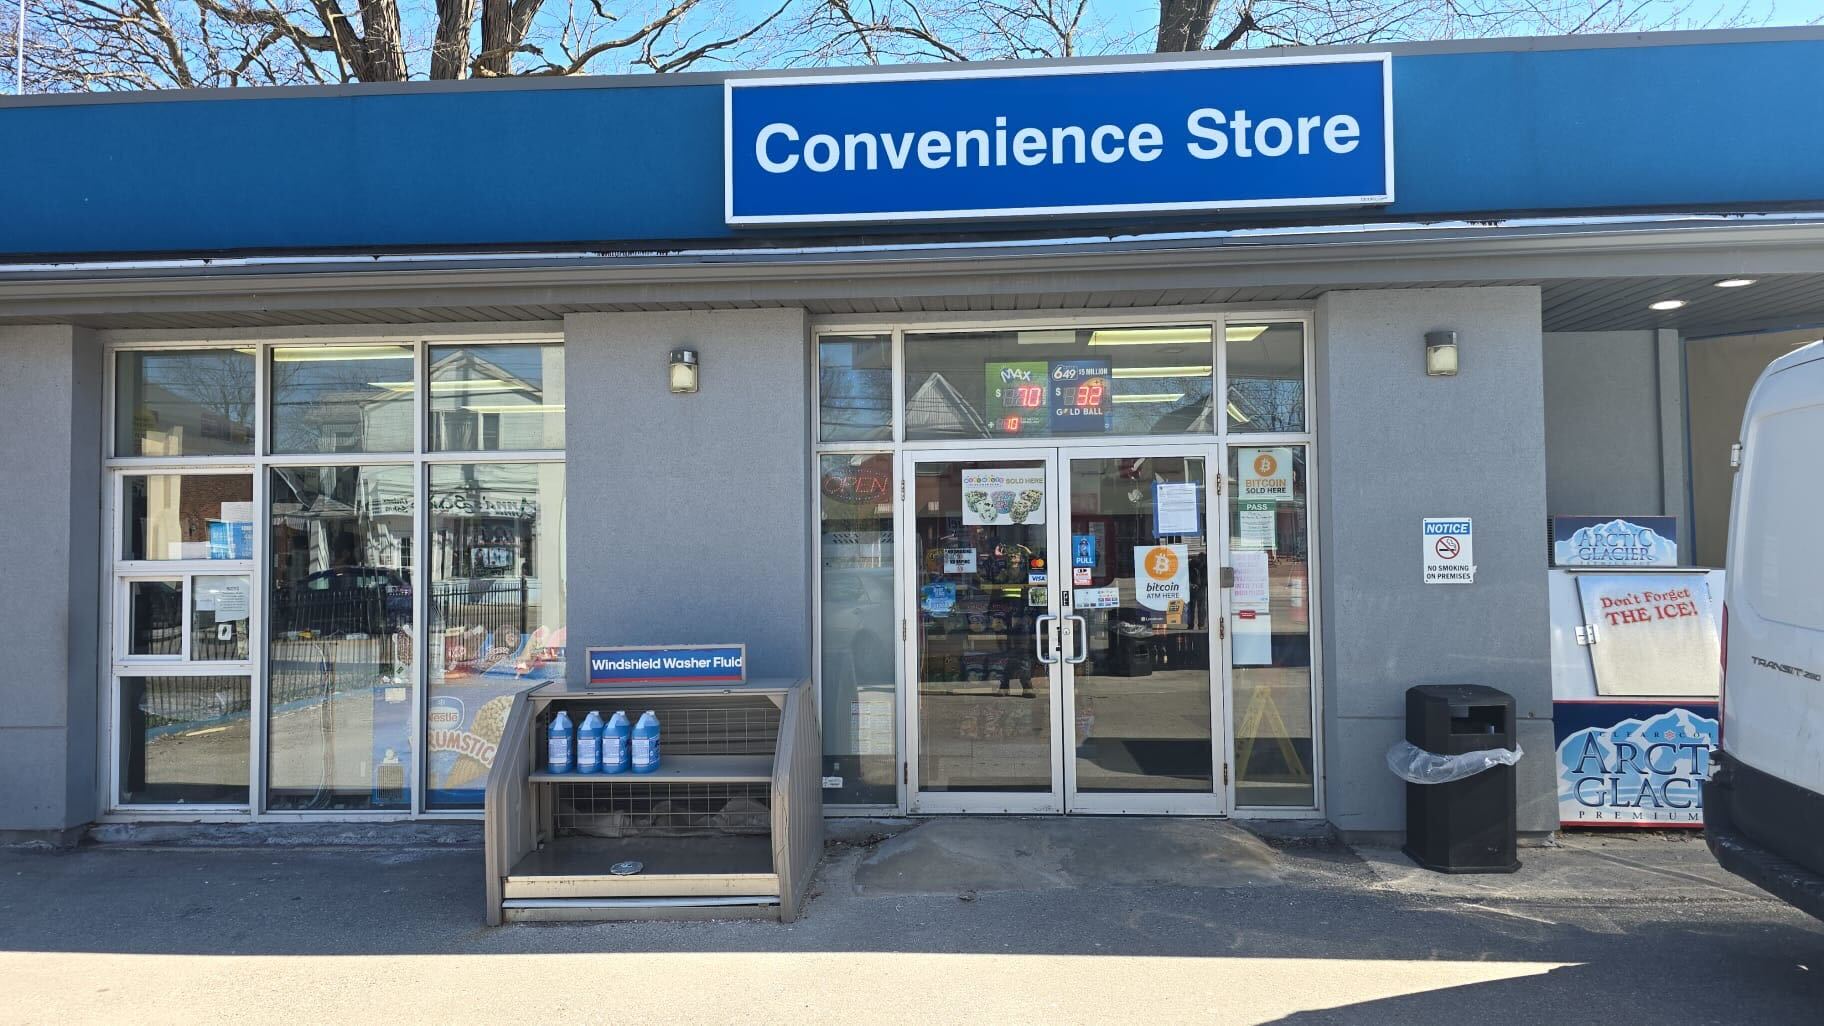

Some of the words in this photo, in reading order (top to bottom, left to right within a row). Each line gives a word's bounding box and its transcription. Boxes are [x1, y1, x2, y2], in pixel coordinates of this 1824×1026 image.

[754, 116, 1164, 174] Convenience
[1185, 106, 1361, 160] Store
[1000, 367, 1031, 383] MAX
[1017, 387, 1041, 407] 70
[1077, 386, 1102, 406] 32
[1026, 476, 1044, 484] HERE
[1246, 478, 1287, 487] BITCOIN
[1246, 487, 1265, 495] SOLD
[1267, 486, 1287, 494] HERE
[1246, 503, 1268, 511] PASS
[1426, 523, 1469, 533] NOTICE
[1578, 529, 1653, 547] ARCTIC
[1579, 547, 1652, 561] GLACIER
[1146, 582, 1180, 592] bitcoin
[1601, 593, 1641, 609] Don't
[1643, 588, 1691, 604] Forget
[1605, 607, 1652, 626] THE
[1656, 602, 1698, 621] ICE!
[592, 658, 661, 670] Windshield
[663, 657, 712, 669] Washer
[713, 656, 743, 668] Fluid
[1751, 656, 1803, 677] TRANSIT
[1571, 730, 1711, 776] ARCT
[1573, 776, 1704, 809] GLACI
[1578, 810, 1699, 820] PREMIUM
